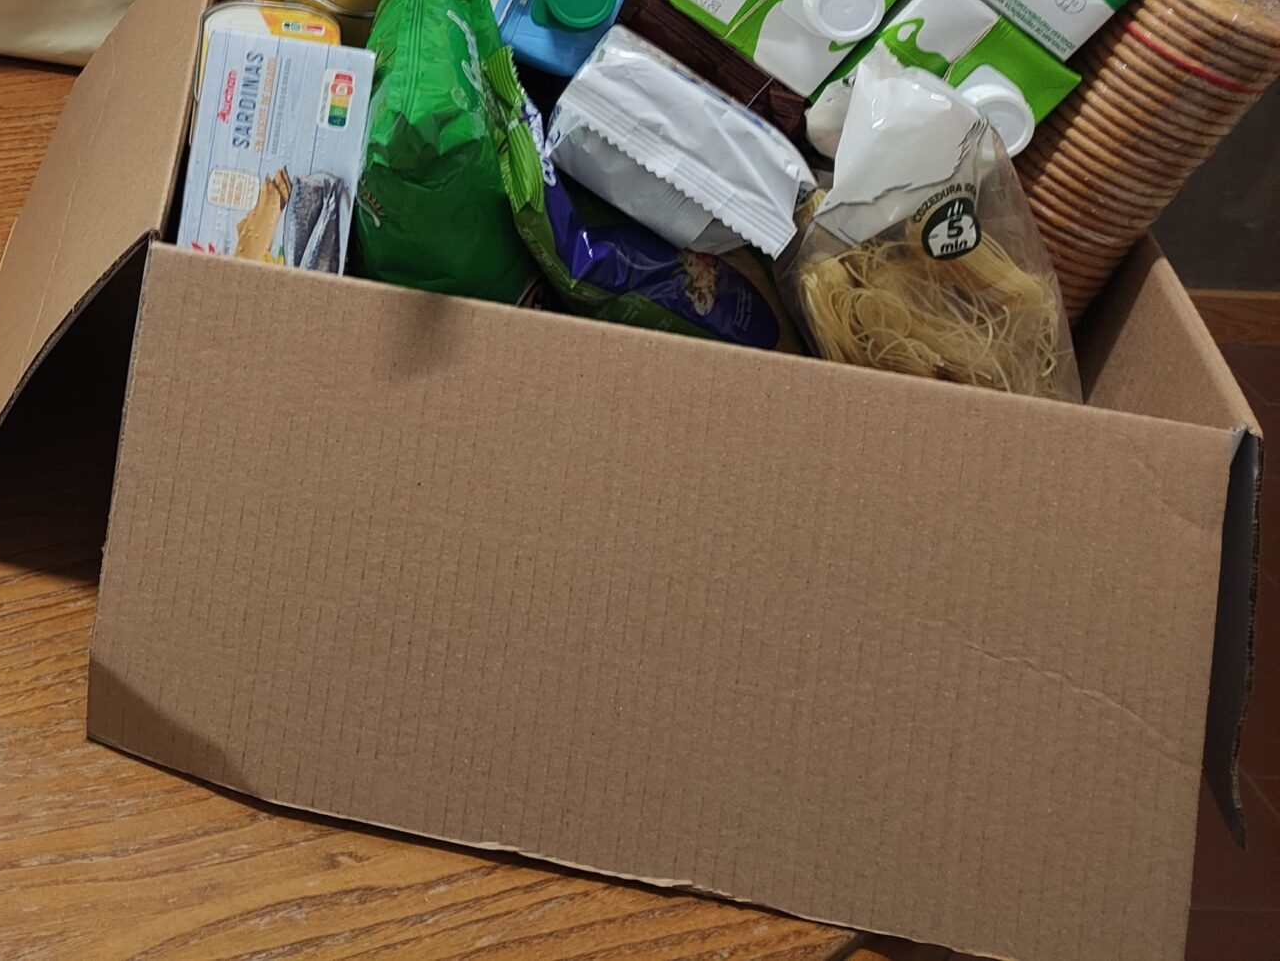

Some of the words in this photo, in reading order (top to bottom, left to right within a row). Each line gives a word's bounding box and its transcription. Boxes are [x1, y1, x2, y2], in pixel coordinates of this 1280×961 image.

[217, 69, 237, 124] Auchan
[232, 51, 265, 150] SARDINAS
[913, 183, 963, 223] COZEDURA
[940, 240, 968, 255] min
[947, 217, 964, 239] 5
